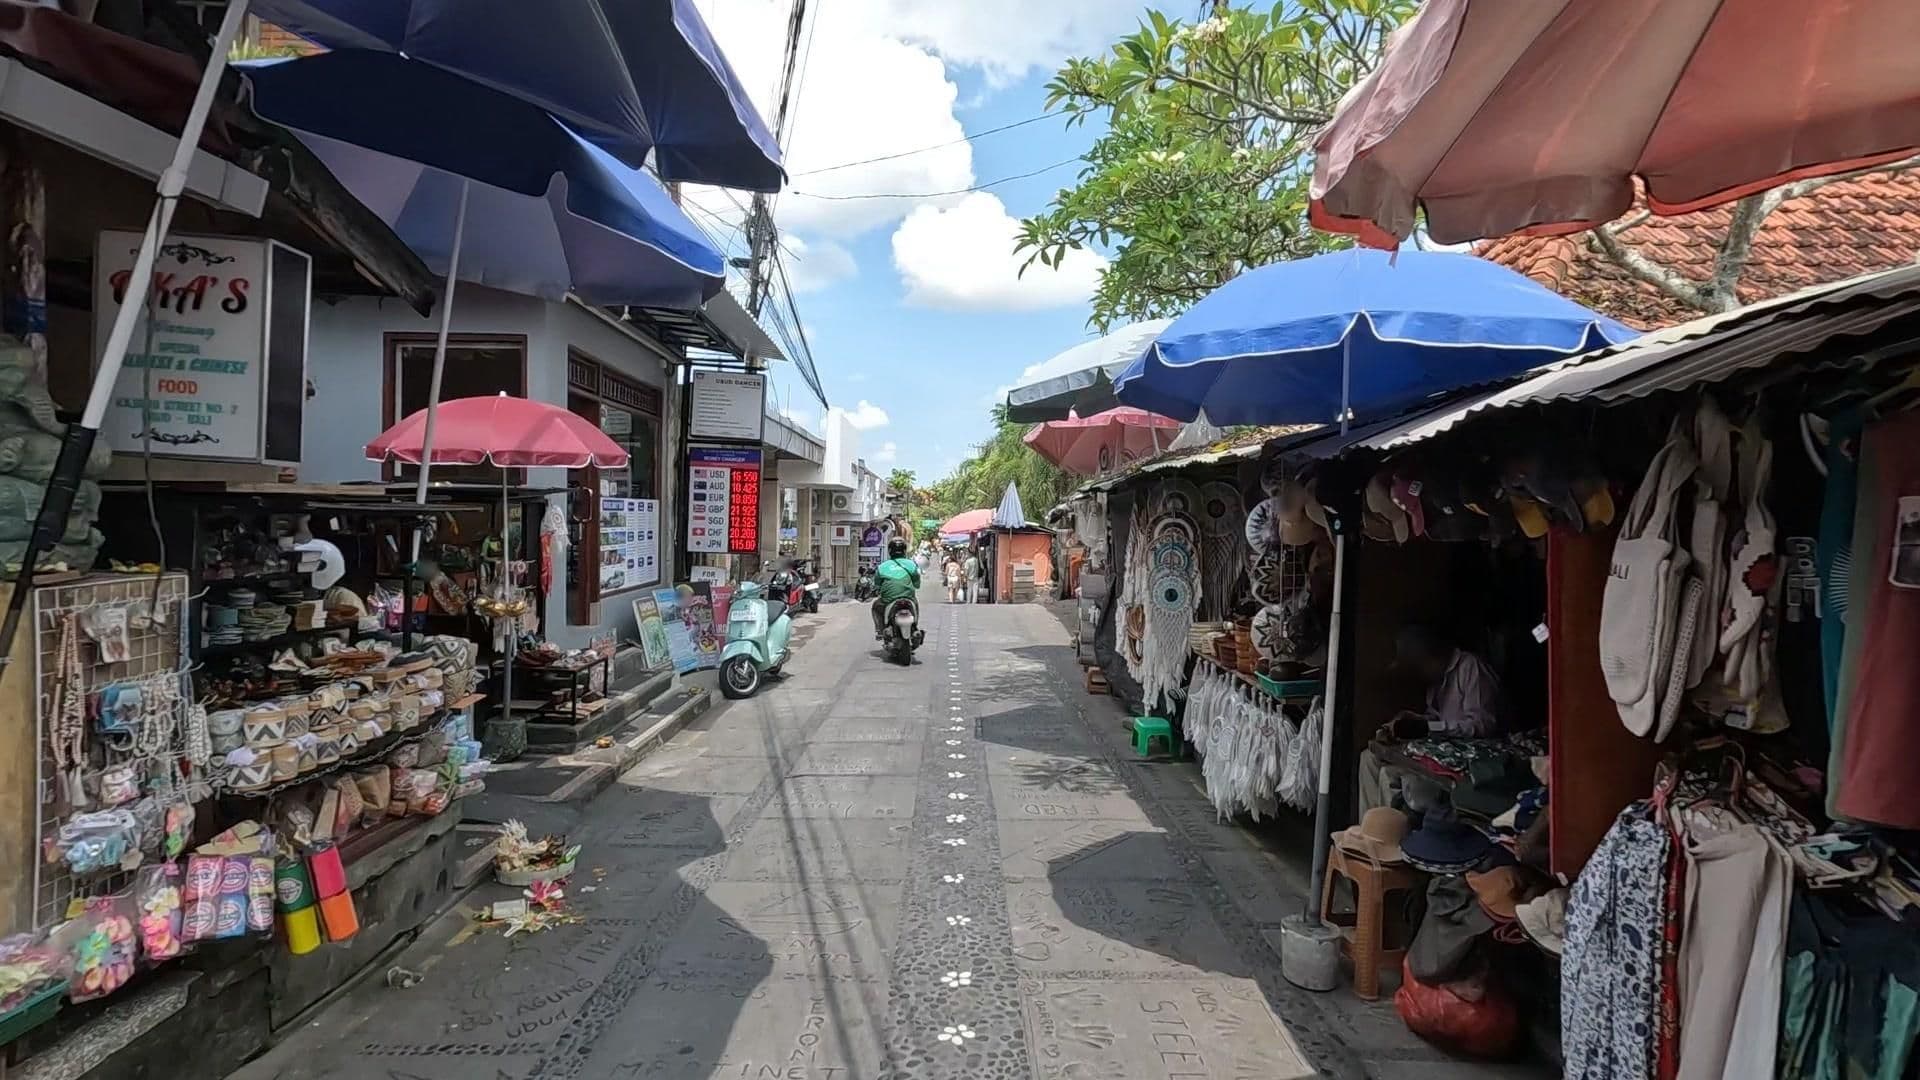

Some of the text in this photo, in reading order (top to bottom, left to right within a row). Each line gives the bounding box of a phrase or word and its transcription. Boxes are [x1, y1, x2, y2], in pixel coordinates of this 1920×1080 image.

[158, 379, 198, 395] FOOD
[709, 470, 725, 478] USD
[709, 482, 725, 490] AUD
[708, 493, 724, 501] EUR
[708, 504, 724, 513] GBP
[708, 516, 724, 525] SGD
[707, 528, 722, 536] CHF
[707, 539, 721, 548] JPN
[702, 570, 715, 578] FOR
[1612, 564, 1630, 580] ALI
